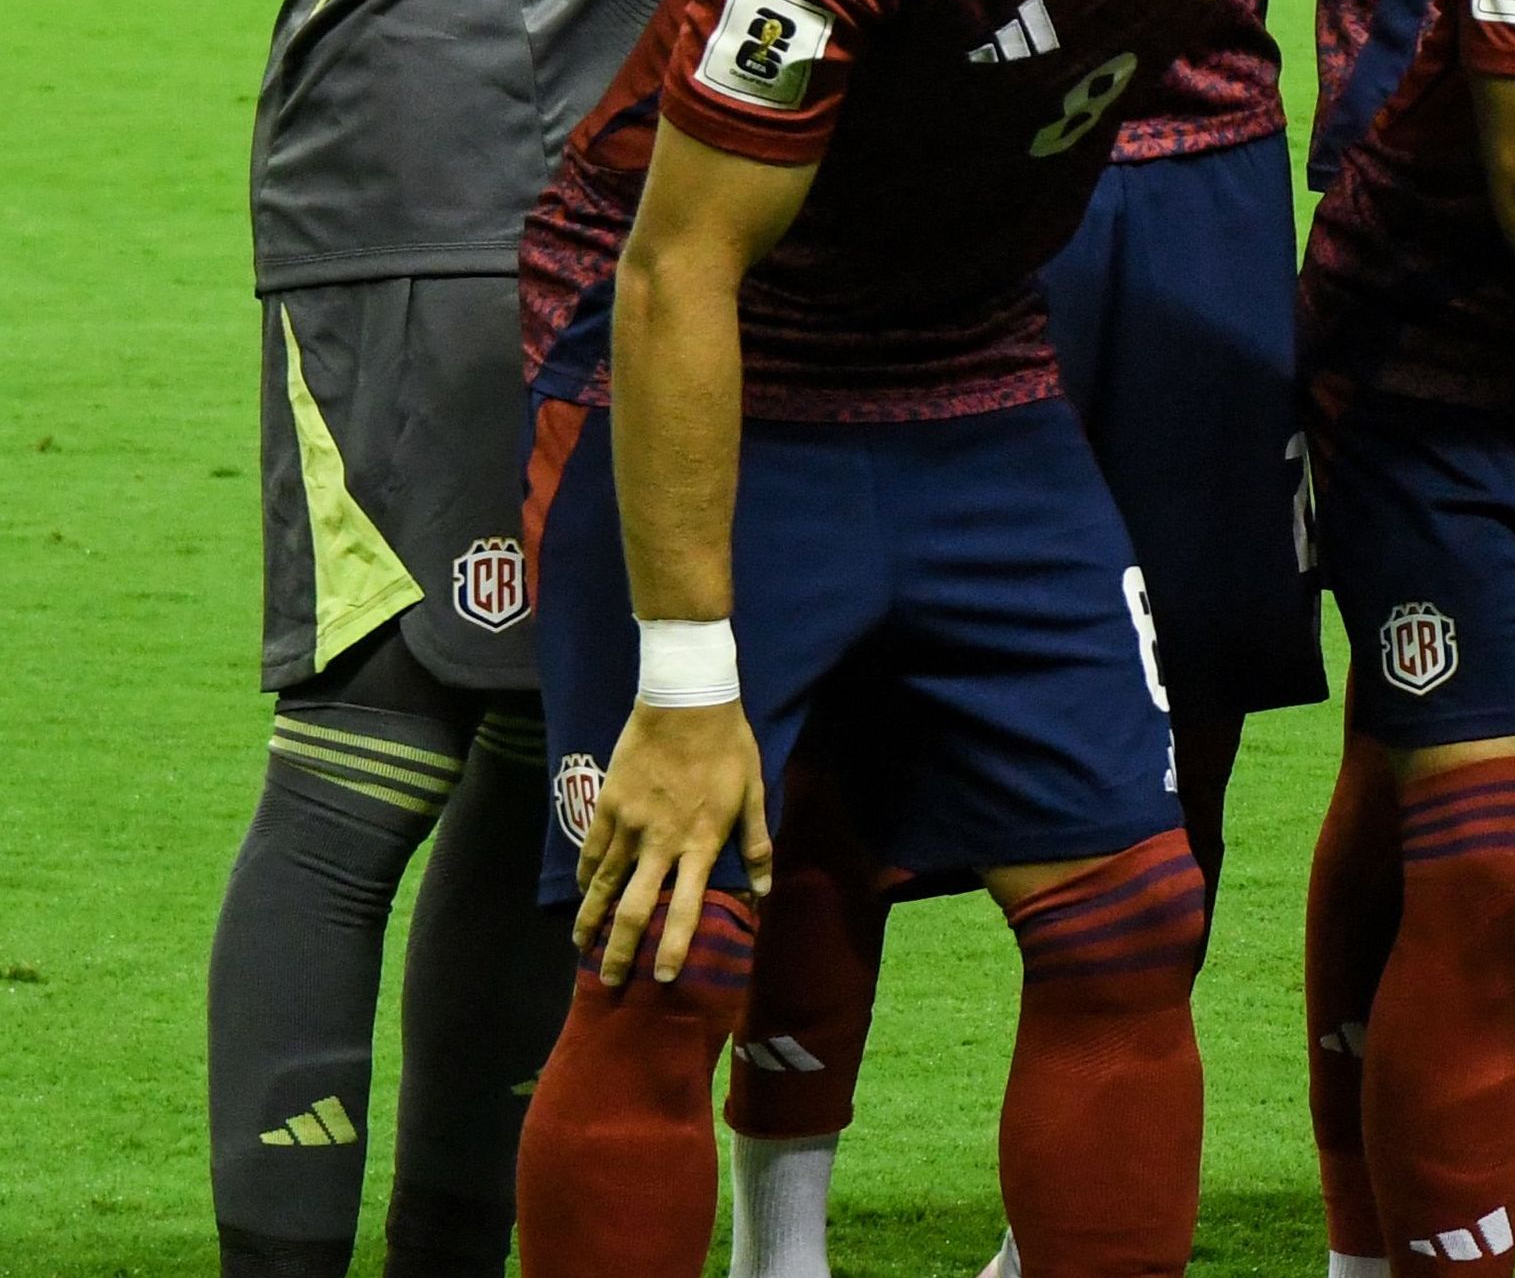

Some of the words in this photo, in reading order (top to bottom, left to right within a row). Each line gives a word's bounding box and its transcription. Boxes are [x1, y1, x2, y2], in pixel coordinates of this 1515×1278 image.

[1029, 52, 1138, 158] 8
[473, 557, 520, 614] CR
[1396, 620, 1438, 678] CR
